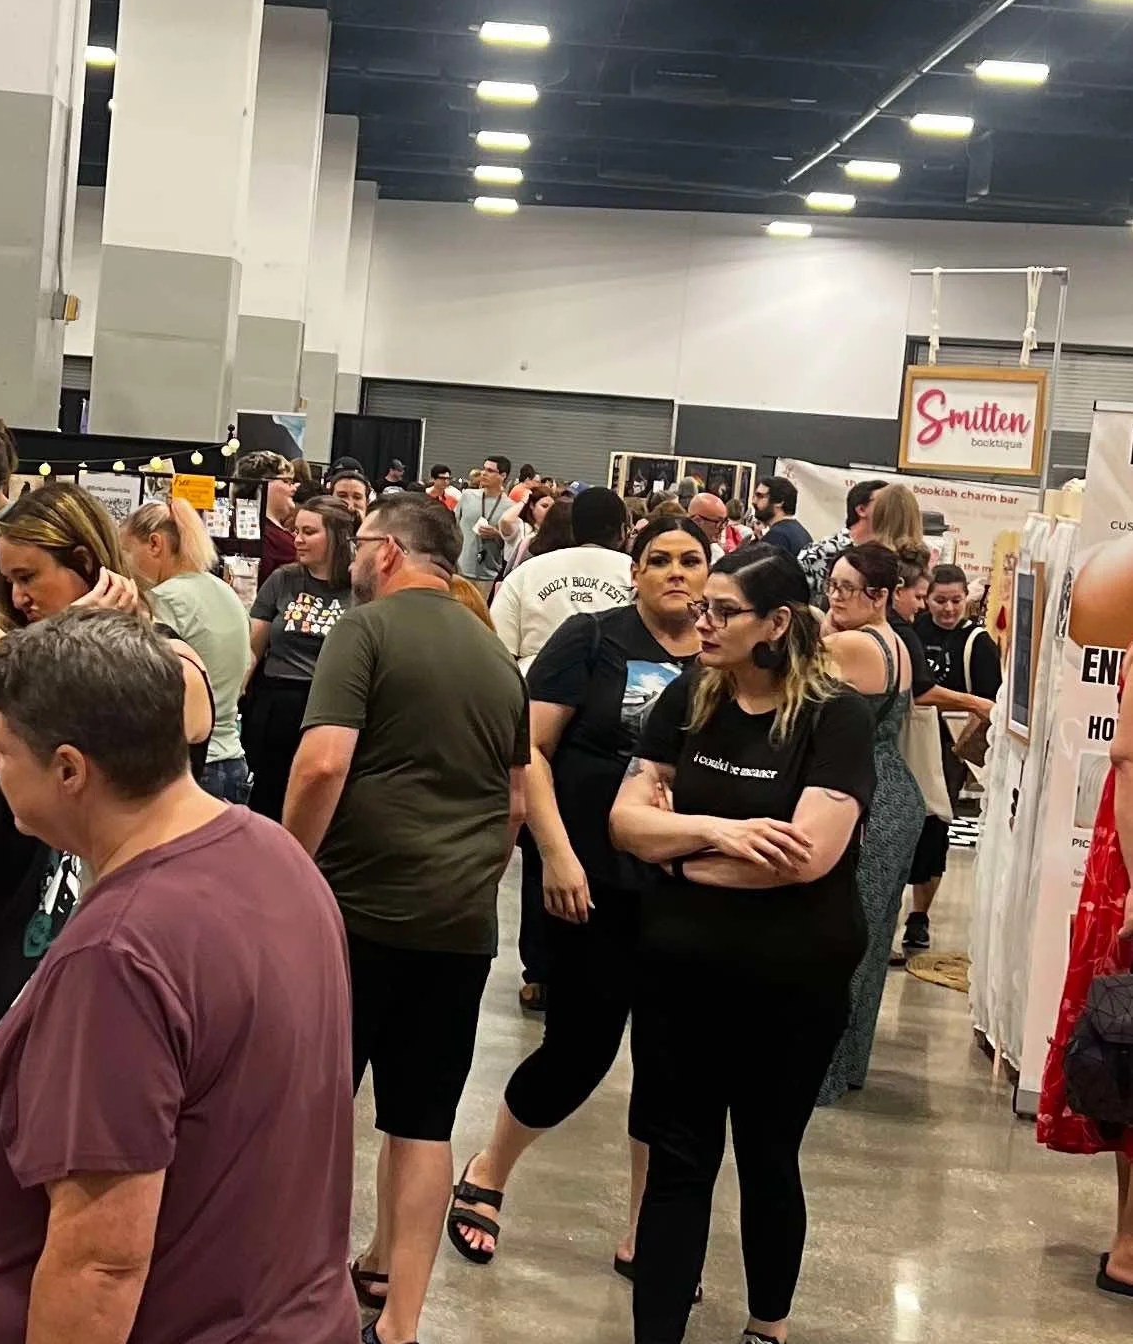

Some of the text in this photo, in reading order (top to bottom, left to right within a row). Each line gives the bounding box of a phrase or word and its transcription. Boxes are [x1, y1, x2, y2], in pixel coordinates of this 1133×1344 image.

[917, 388, 1030, 446] Smitten
[913, 485, 958, 498] bookish
[960, 491, 997, 502] charm
[1000, 495, 1019, 505] bar
[570, 590, 593, 602] 2025
[572, 576, 599, 590] BOOK
[600, 582, 627, 604] FEST
[328, 599, 341, 610] A
[284, 619, 296, 632] A
